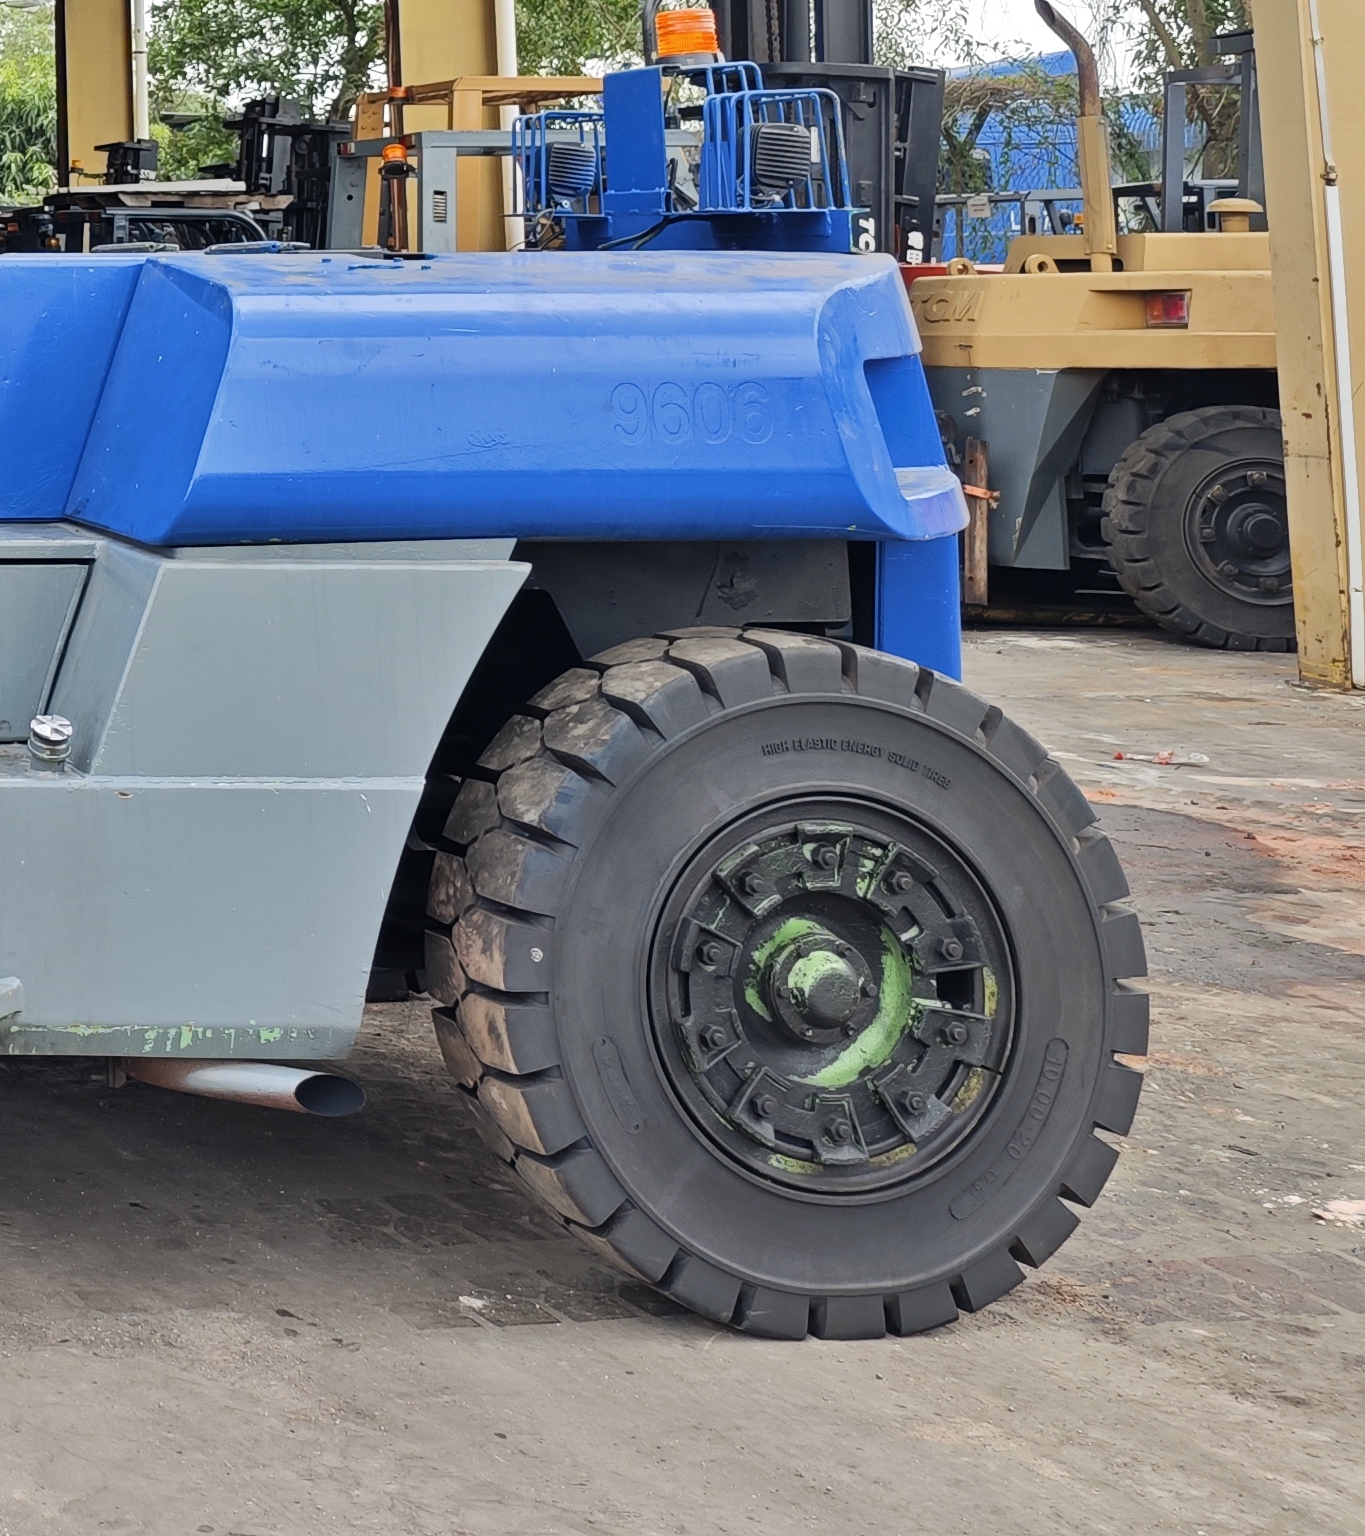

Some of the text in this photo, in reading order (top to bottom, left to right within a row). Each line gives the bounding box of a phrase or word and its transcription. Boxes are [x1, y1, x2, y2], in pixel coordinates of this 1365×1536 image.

[610, 381, 774, 446] 9606
[761, 737, 953, 791] HIGH ELASTIC ENERGY SOLID TIRES
